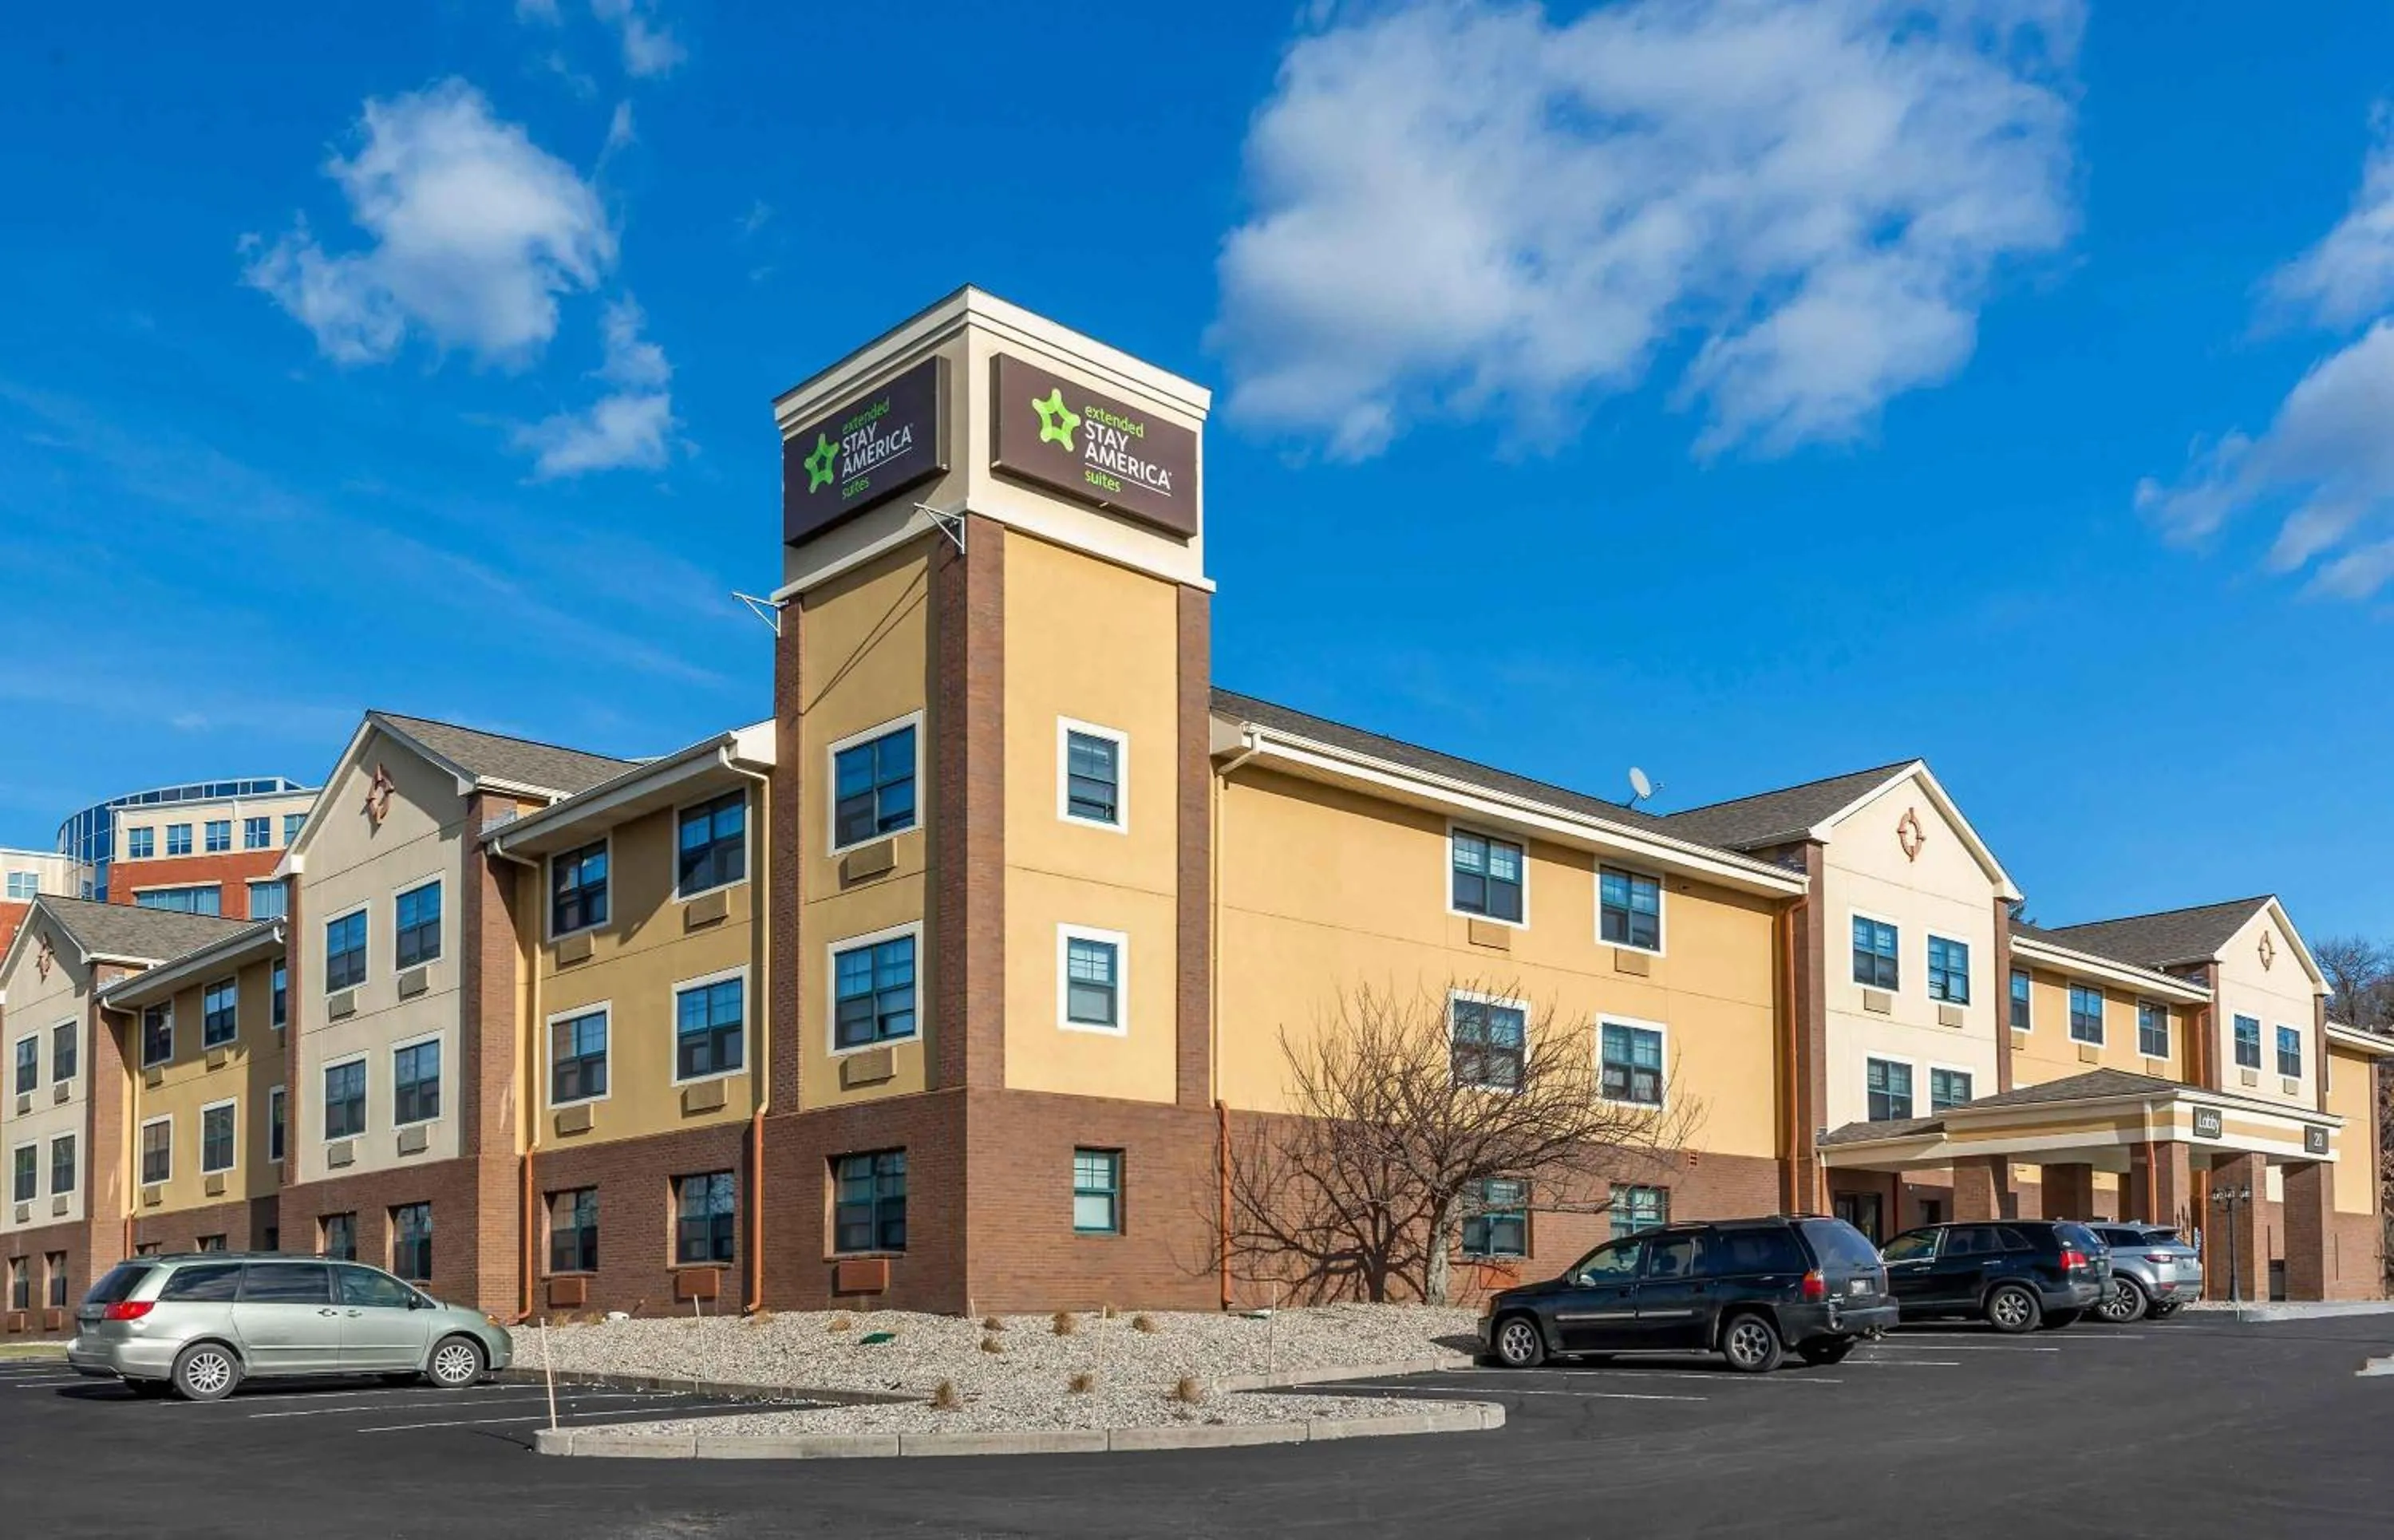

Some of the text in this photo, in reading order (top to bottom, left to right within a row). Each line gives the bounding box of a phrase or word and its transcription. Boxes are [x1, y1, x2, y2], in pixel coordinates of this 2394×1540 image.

[842, 396, 890, 435] extended
[1084, 405, 1144, 438] extended
[842, 421, 877, 457] STAY
[842, 424, 912, 478] AMERICA
[1084, 420, 1129, 452] STAY
[1084, 440, 1171, 490] AMERICA
[1084, 470, 1122, 493] suites
[842, 476, 870, 500] suites
[2198, 1112, 2221, 1134] Lobby
